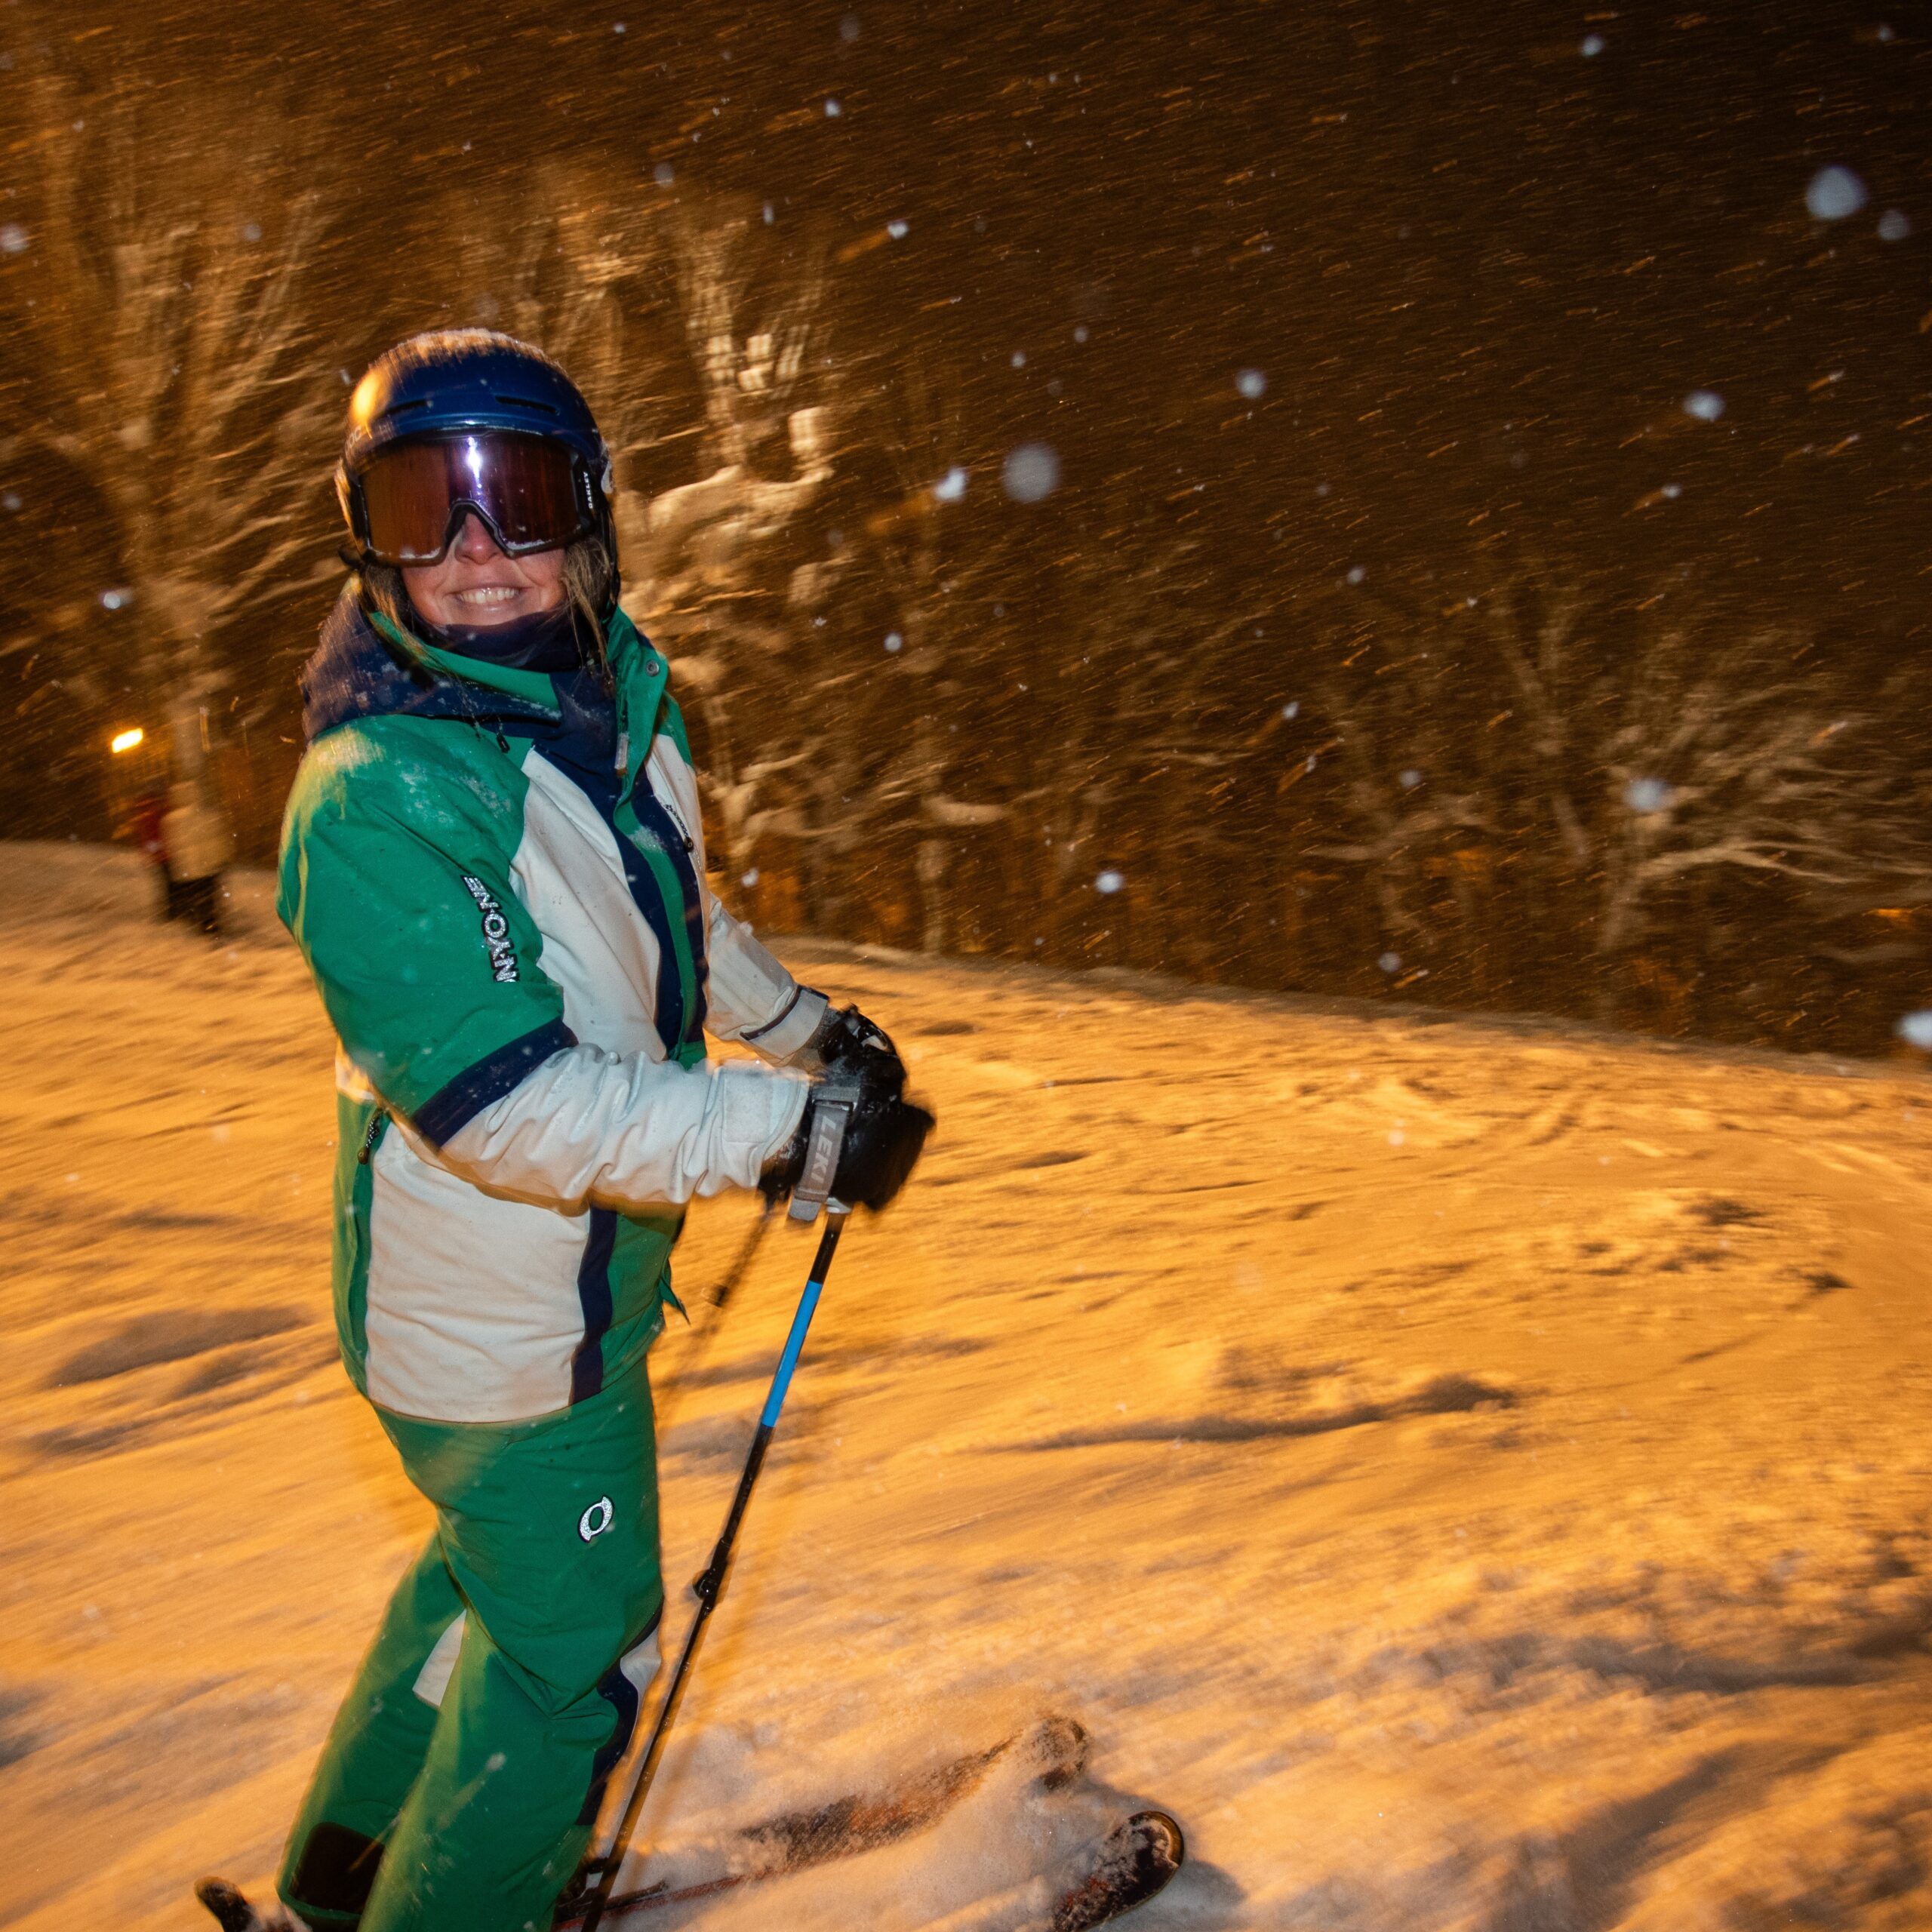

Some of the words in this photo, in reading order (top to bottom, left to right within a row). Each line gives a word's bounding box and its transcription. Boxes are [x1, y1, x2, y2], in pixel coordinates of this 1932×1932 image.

[583, 471, 594, 509] OAKLEY
[462, 875, 518, 983] NYONE
[810, 1115, 837, 1184] LEKI
